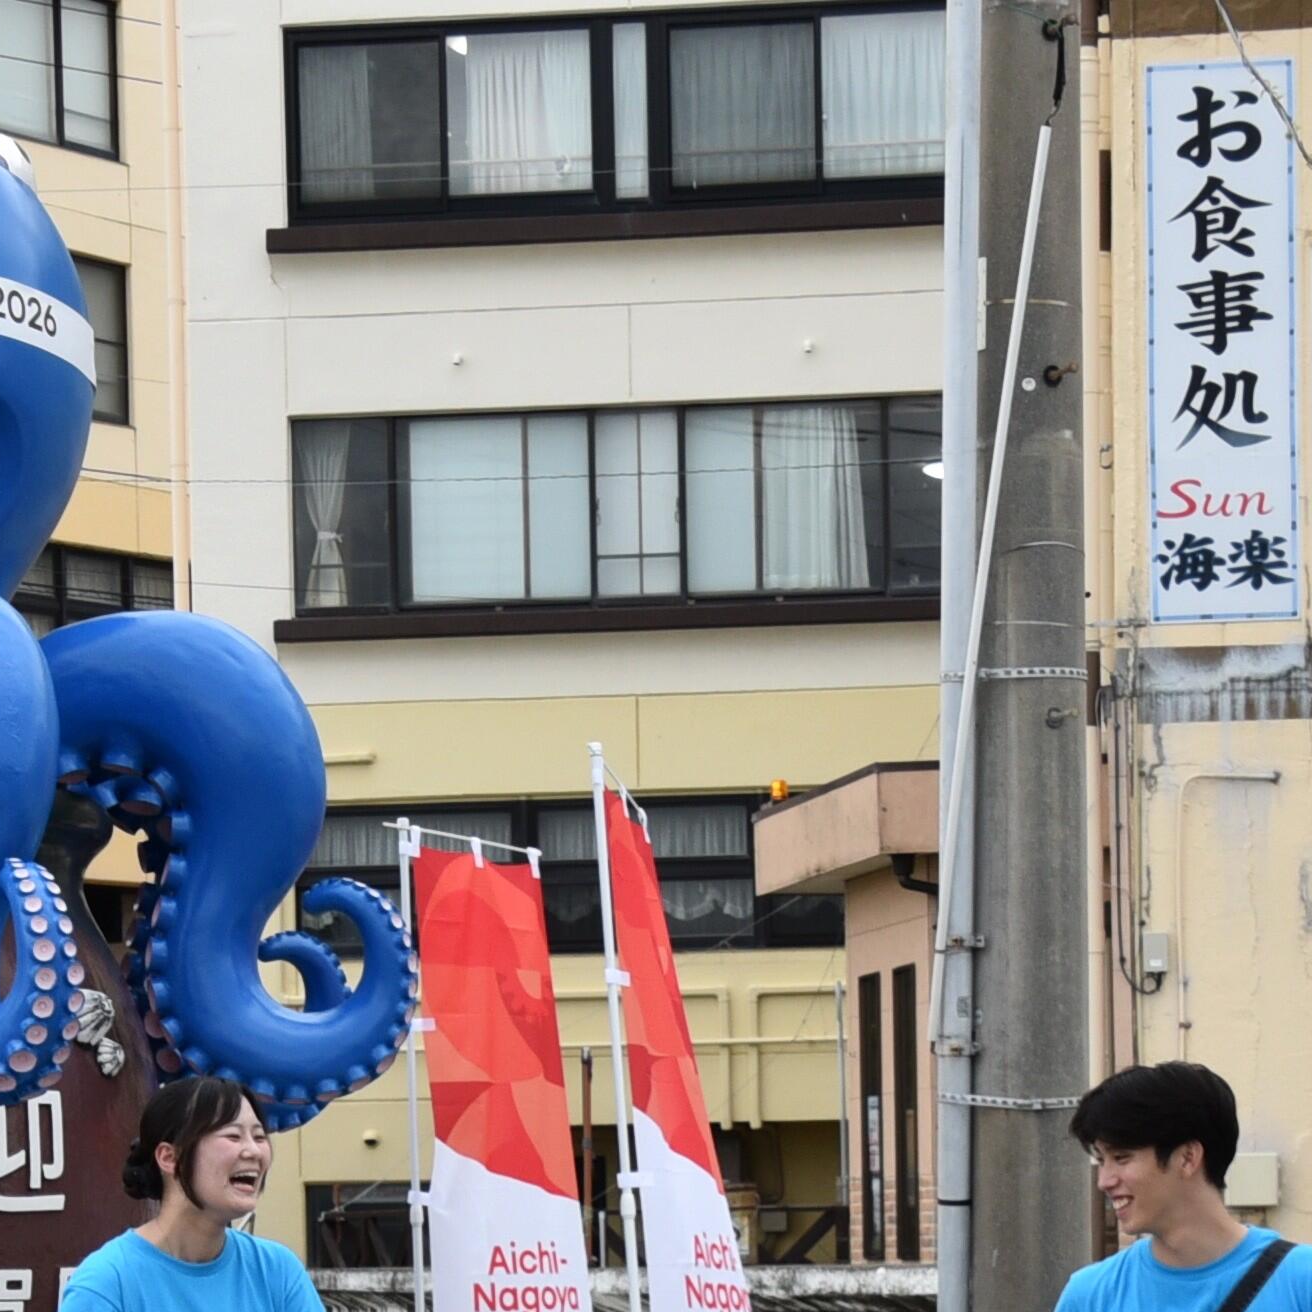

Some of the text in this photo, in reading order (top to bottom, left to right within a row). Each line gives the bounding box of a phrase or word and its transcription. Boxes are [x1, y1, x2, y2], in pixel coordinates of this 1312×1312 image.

[1167, 85, 1274, 452] お食事処
[1156, 479, 1275, 520] Sun
[1153, 528, 1296, 592] 海楽
[488, 1240, 568, 1276] Aichi-
